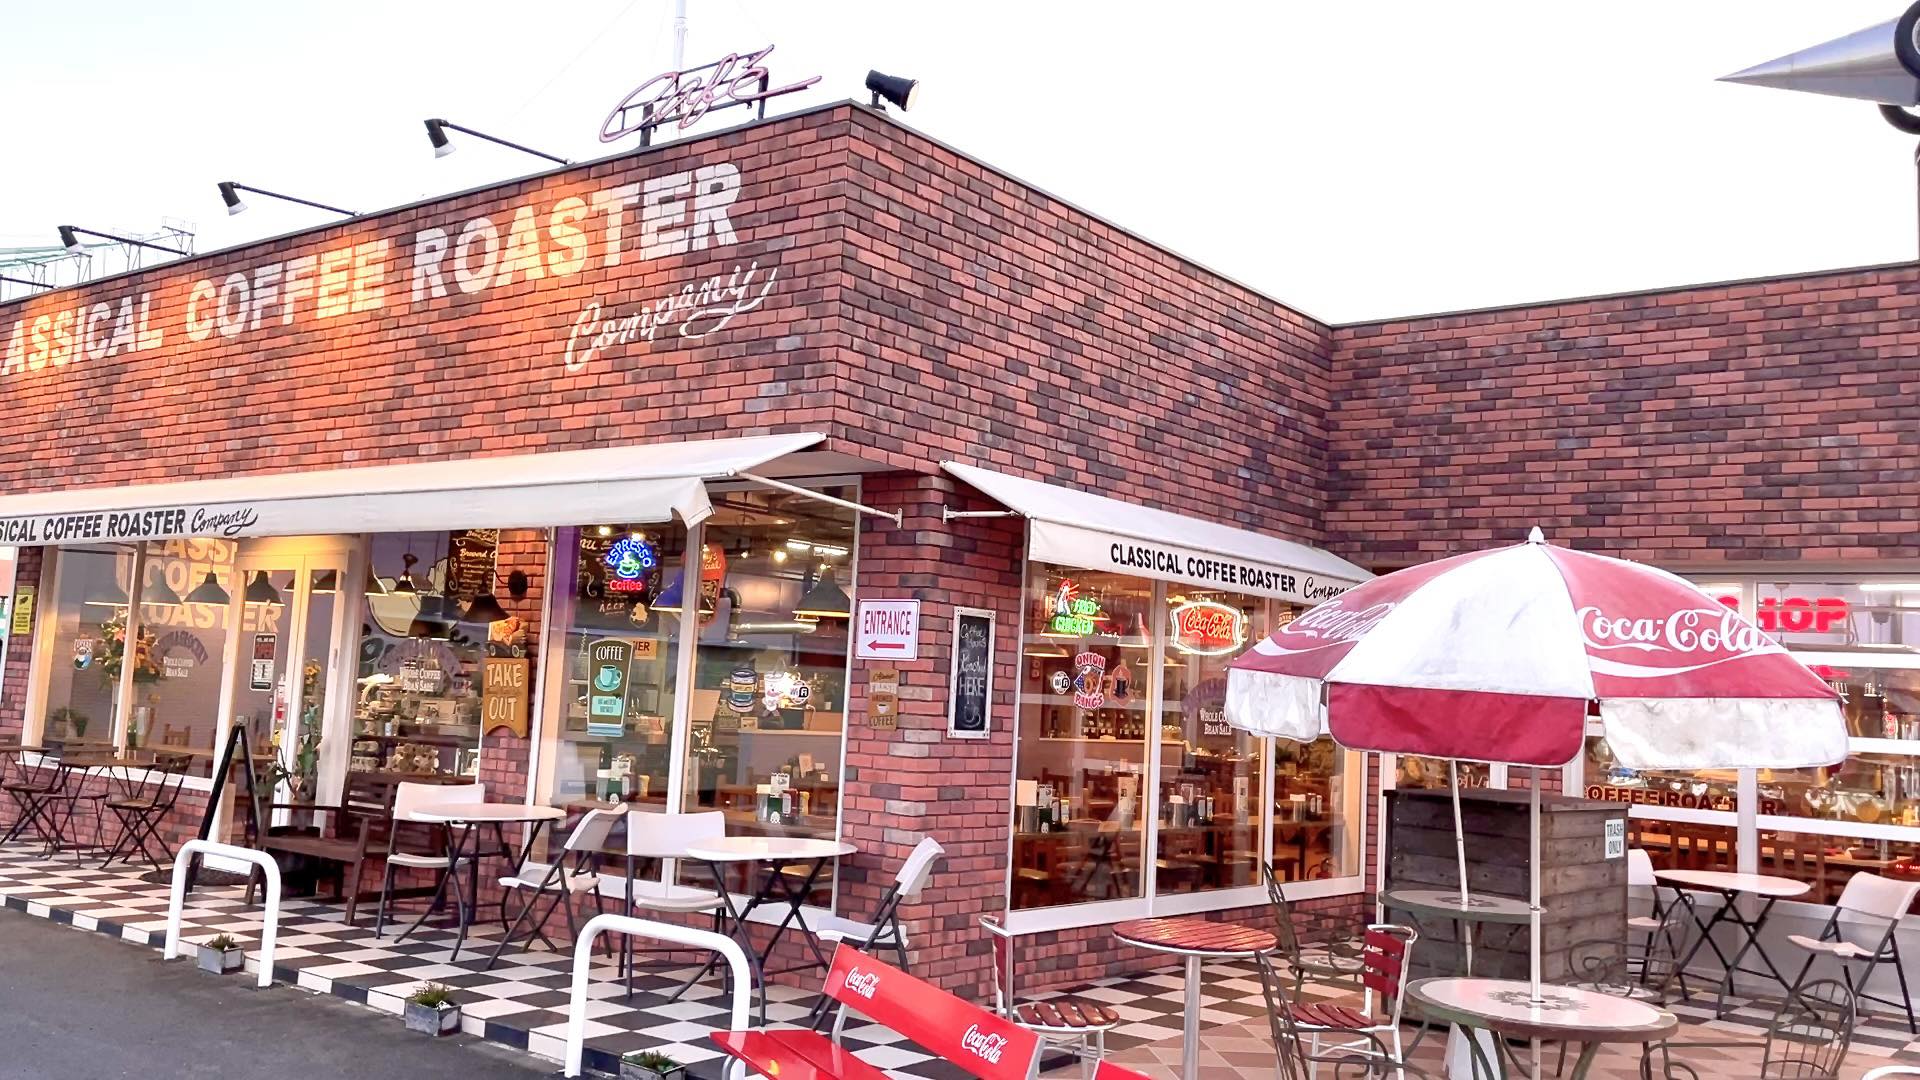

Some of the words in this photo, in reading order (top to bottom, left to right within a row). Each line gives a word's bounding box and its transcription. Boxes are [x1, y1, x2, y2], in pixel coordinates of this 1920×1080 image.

[186, 238, 390, 342] COFFEE
[412, 162, 742, 301] ROASTER
[564, 262, 777, 372] Company
[43, 514, 103, 541] COFFEE
[106, 509, 187, 538] ROASTER
[191, 507, 258, 537] Company
[606, 539, 652, 568] ESPRESSO
[1110, 543, 1183, 575] CLASSICAL
[1186, 558, 1237, 584] COFFEE
[1239, 568, 1297, 594] ROASTER
[1303, 576, 1350, 601] Compan
[609, 580, 643, 591] Coffee
[1072, 599, 1097, 615] FRIED
[864, 610, 912, 636] ENTRANCE
[1053, 616, 1094, 635] CHICKEN
[1184, 607, 1232, 639] Coca-Cola
[1577, 606, 1768, 652] Coca-Cola
[595, 645, 625, 661] COFFEE
[1075, 652, 1106, 670] ONION
[486, 663, 522, 688] TAKE
[959, 676, 985, 697] HERE
[488, 695, 517, 721] OUT
[1074, 692, 1104, 709] RINGS
[869, 714, 895, 727] COFFEE
[1200, 708, 1218, 722] WHOLE
[1204, 723, 1218, 735] BEAN
[1582, 785, 1660, 805] OFFEE
[1606, 822, 1624, 838] TRASH
[1608, 839, 1622, 855] ONLY
[844, 966, 880, 999] Coca-Cola
[961, 1023, 1009, 1065] Coca-Cola
